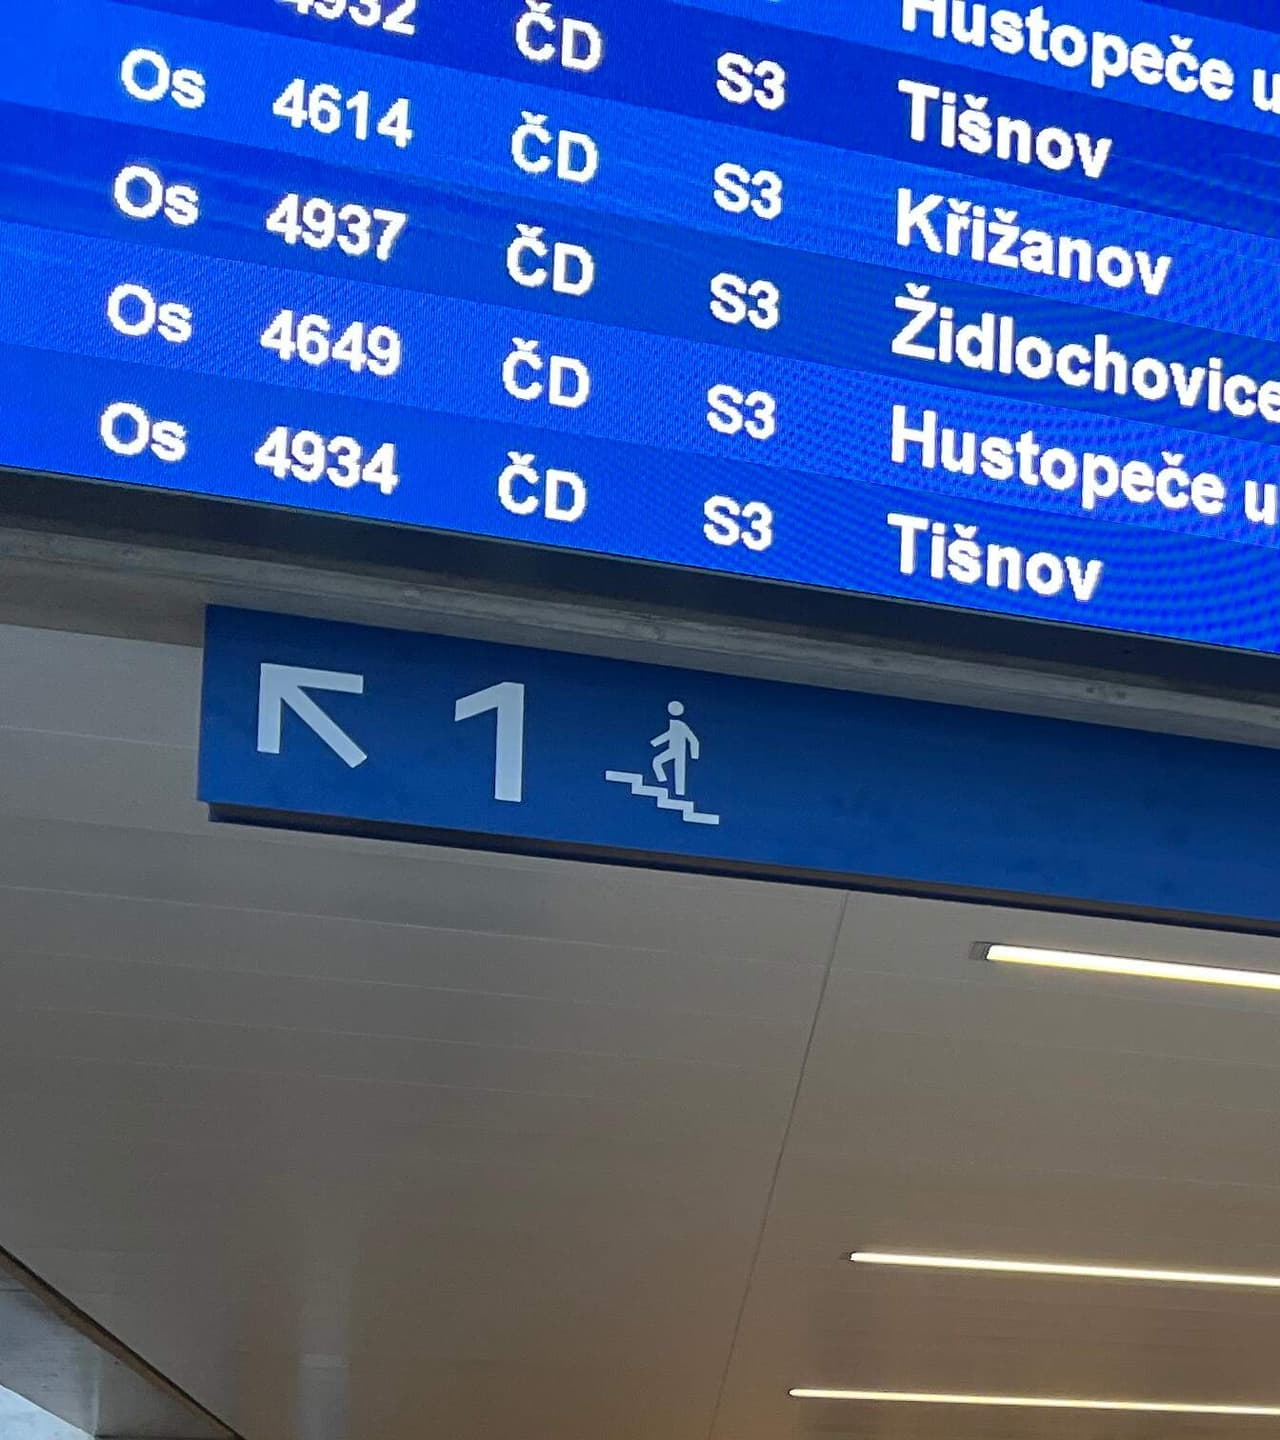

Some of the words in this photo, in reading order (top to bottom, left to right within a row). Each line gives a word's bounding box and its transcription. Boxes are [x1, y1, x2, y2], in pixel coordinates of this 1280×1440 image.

[515, 0, 602, 72] ČD
[901, 0, 1235, 102] Hustopeče
[120, 48, 206, 109] Os
[272, 78, 413, 148] 4614
[716, 52, 786, 111] S3
[511, 110, 598, 183] ČD
[897, 78, 1113, 179] Tišnov
[113, 165, 199, 226] Os
[713, 162, 783, 220] S3
[265, 193, 407, 261] 4937
[506, 223, 595, 296] ČD
[895, 187, 1172, 296] Křižanov
[106, 283, 193, 344] Os
[710, 272, 780, 330] S3
[260, 309, 401, 377] 4649
[502, 337, 590, 409] ČD
[100, 401, 187, 462] Os
[706, 383, 776, 440] S3
[254, 426, 399, 495] 4934
[498, 451, 587, 522] ČD
[890, 404, 1226, 516] Hustopeče
[1244, 480, 1278, 526] u
[703, 495, 773, 551] S3
[887, 512, 1103, 601] Tišnov
[454, 681, 525, 803] 1
